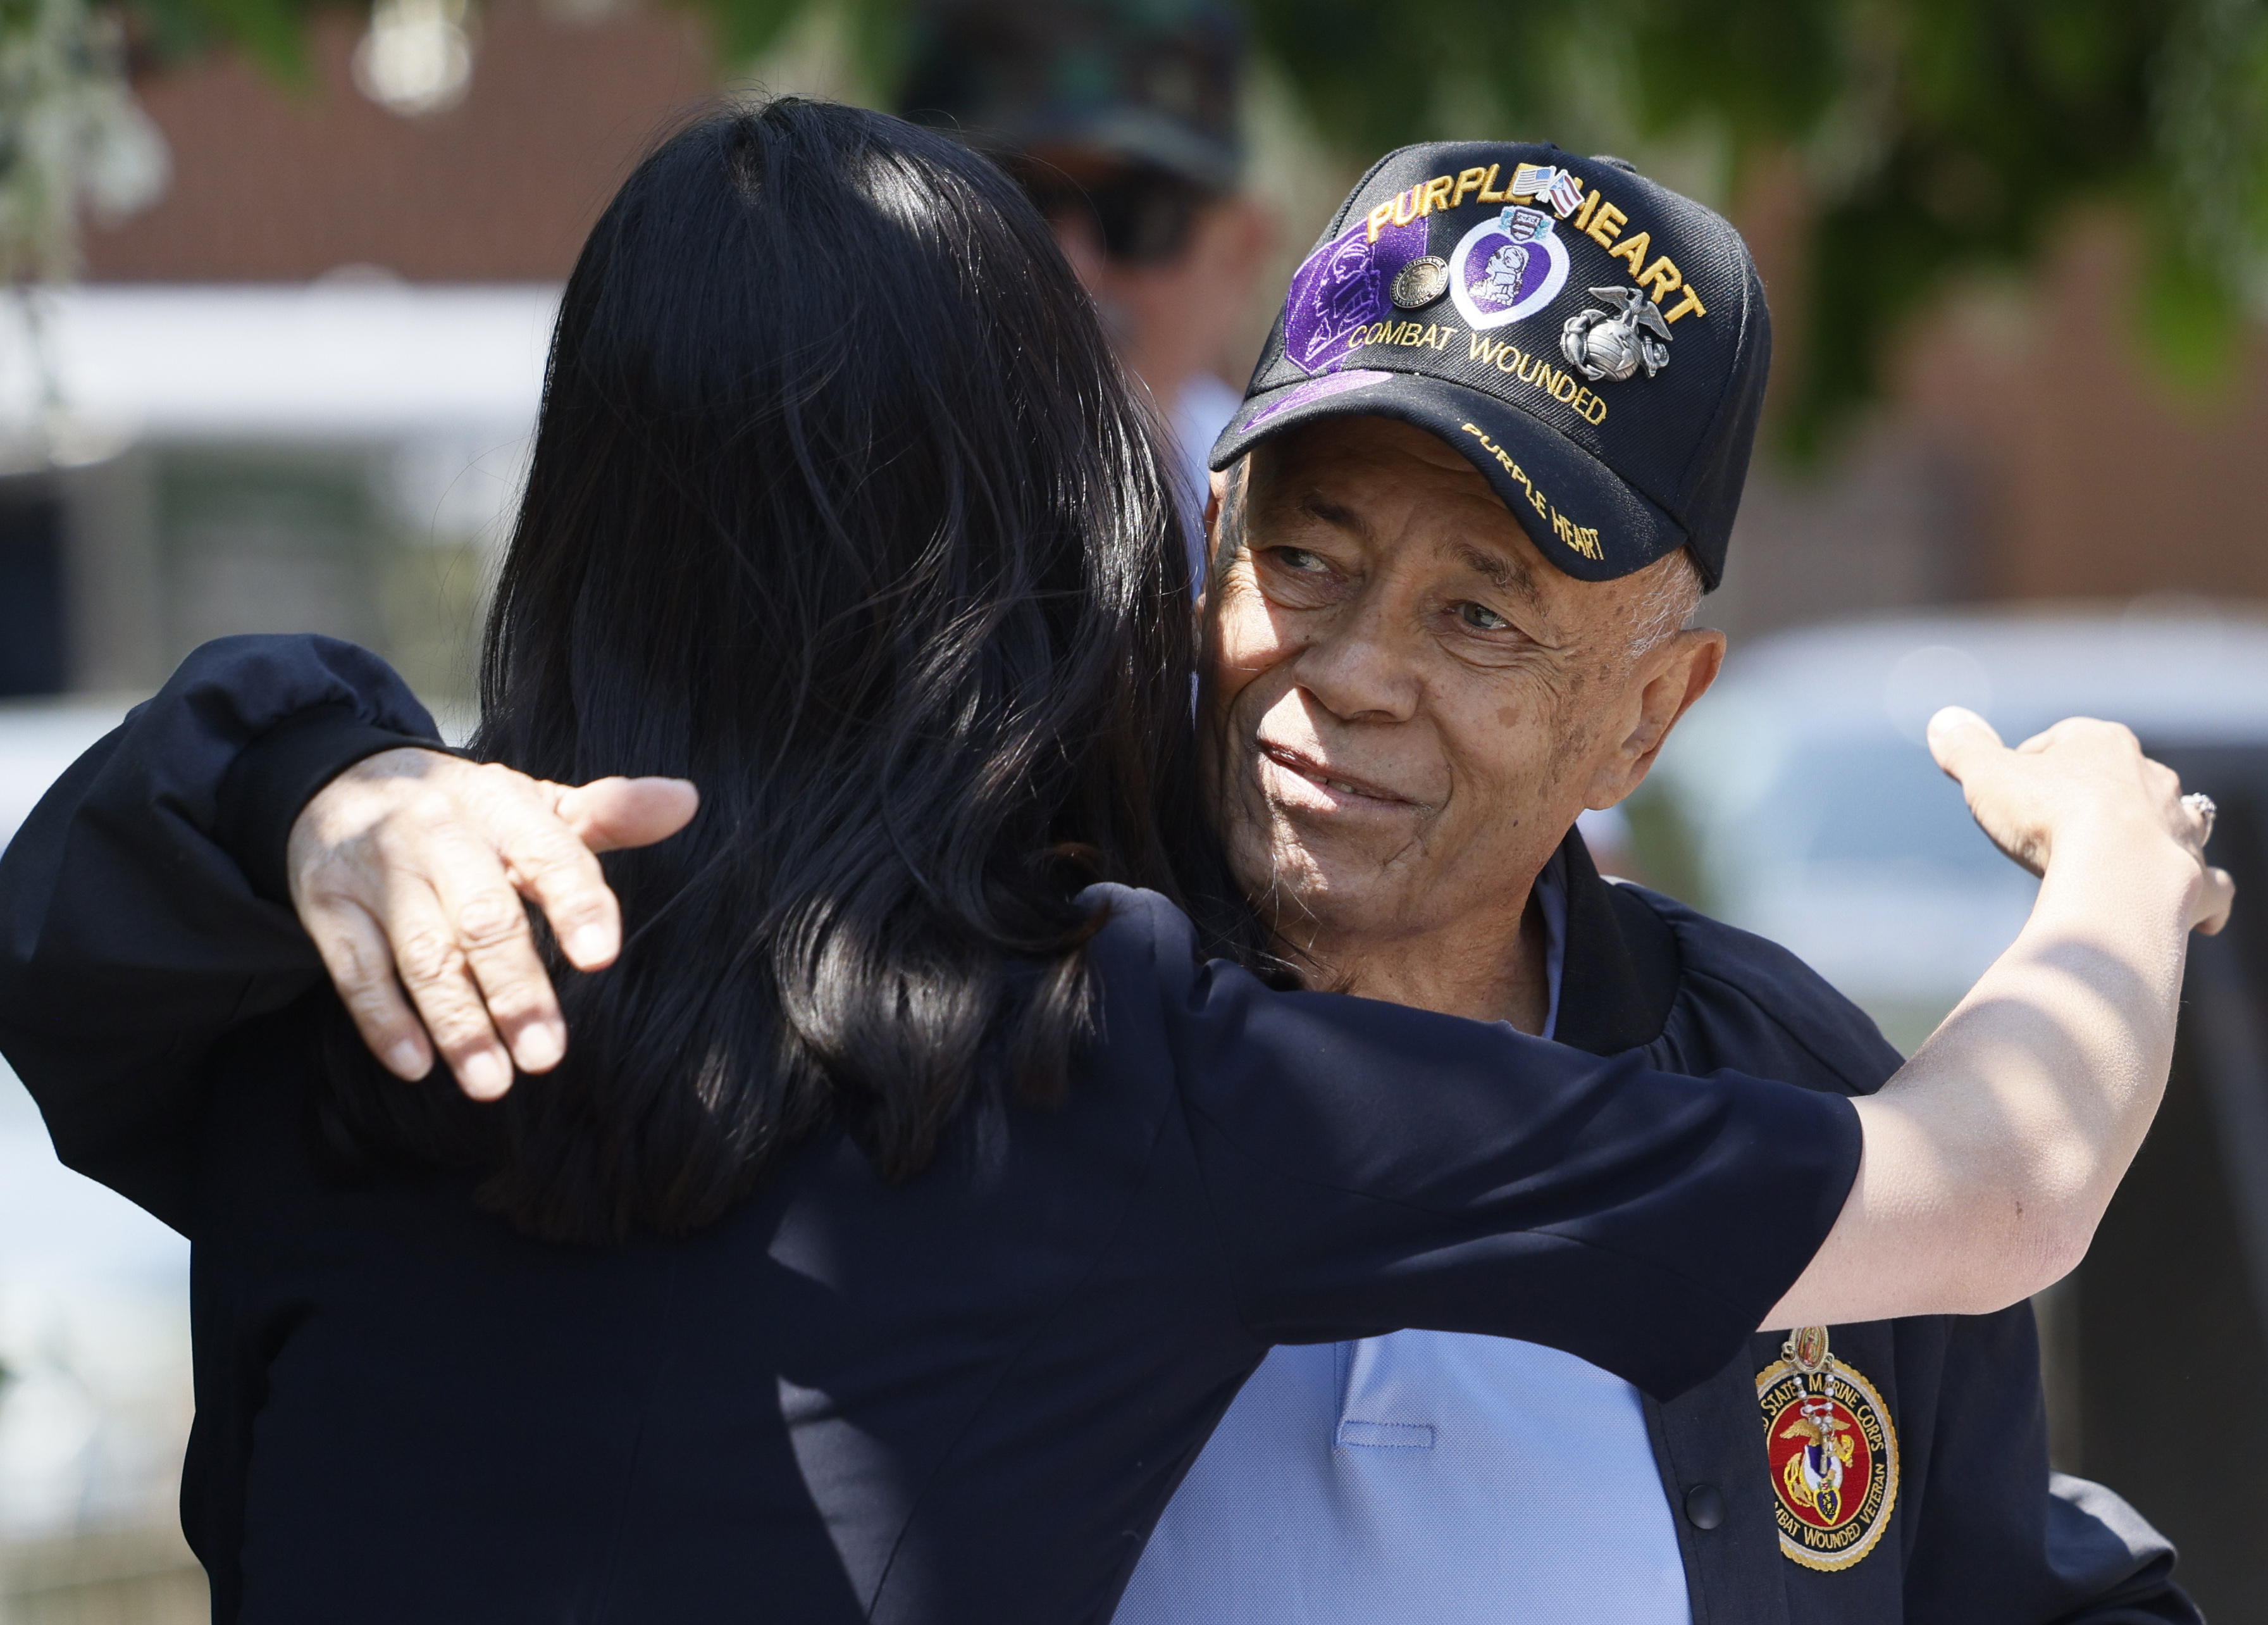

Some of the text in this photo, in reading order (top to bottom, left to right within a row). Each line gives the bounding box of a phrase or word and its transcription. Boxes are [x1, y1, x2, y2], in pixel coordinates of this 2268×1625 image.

[1348, 321, 1608, 426] COMBAT WOUNDED
[1461, 423, 1604, 560] PURPLE HEART
[1761, 1380, 1799, 1416] STATE
[1857, 1405, 1884, 1452] CORPS
[1804, 1522, 1861, 1549] WOUNDED
[1859, 1463, 1885, 1524] VETERAN
